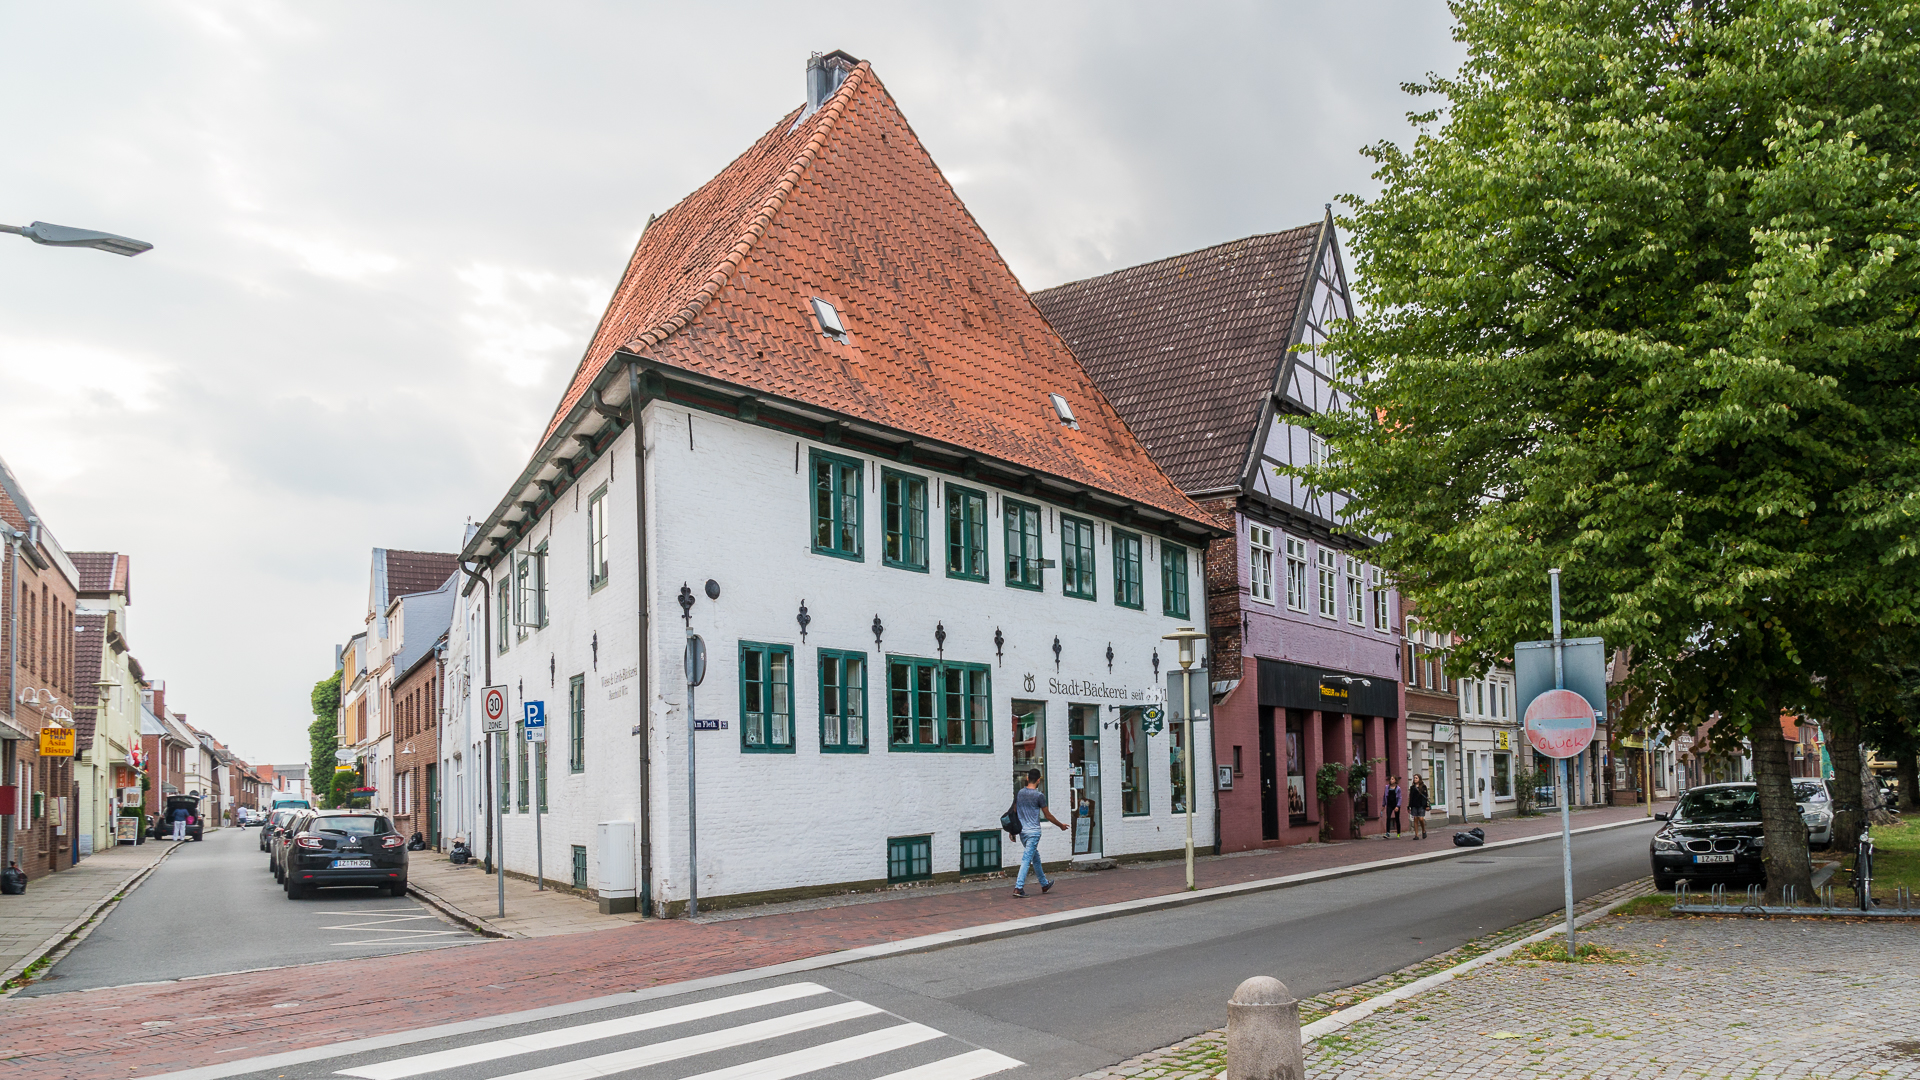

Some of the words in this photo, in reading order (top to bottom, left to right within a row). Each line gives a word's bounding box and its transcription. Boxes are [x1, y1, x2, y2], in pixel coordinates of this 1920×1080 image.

[1048, 677, 1128, 700] Stadt-Bäckerei
[1131, 688, 1144, 701] seit
[489, 697, 500, 712] 30
[527, 704, 539, 725] P
[42, 728, 72, 736] CHINA
[488, 720, 502, 730] ZONE
[44, 746, 71, 754] Bistro
[1538, 736, 1584, 750] GLÜCK
